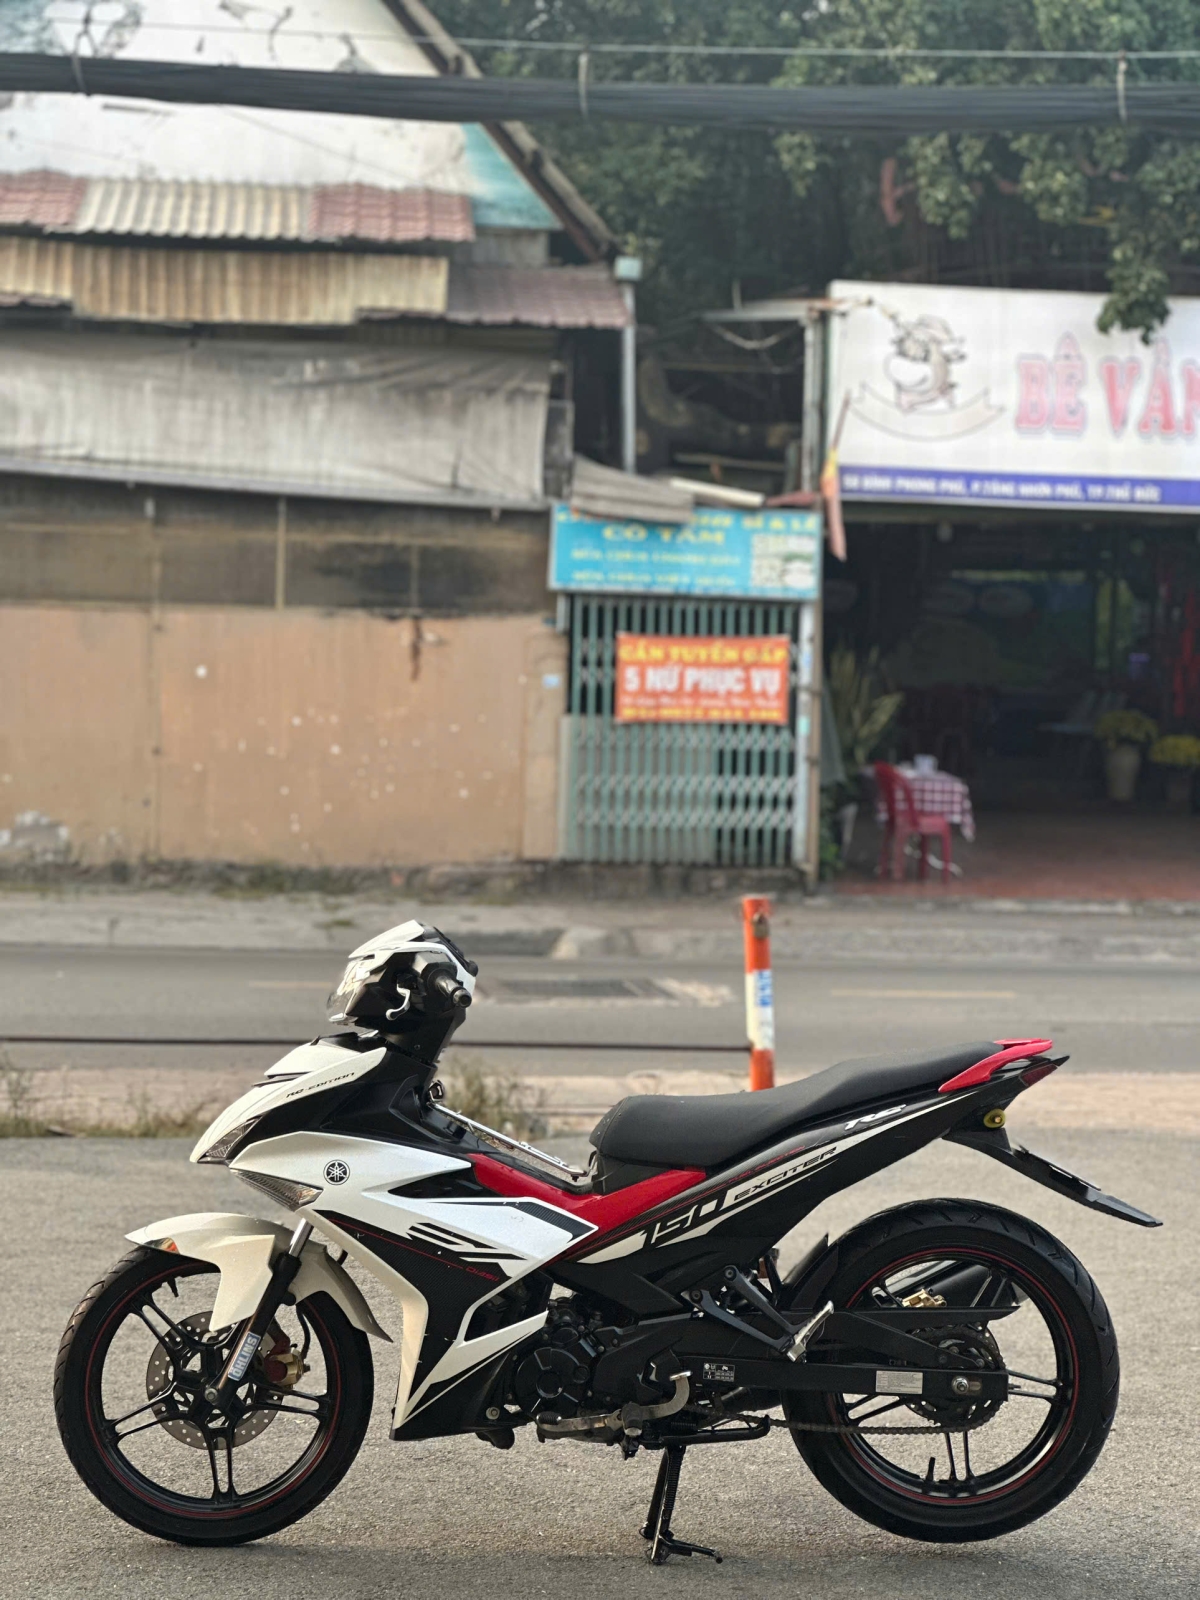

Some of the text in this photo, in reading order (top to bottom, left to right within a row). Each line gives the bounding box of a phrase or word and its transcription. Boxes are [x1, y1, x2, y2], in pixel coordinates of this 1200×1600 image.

[1016, 330, 1086, 436] BÊ
[684, 667, 746, 698] PHỤC
[733, 1146, 838, 1202] EXCITER
